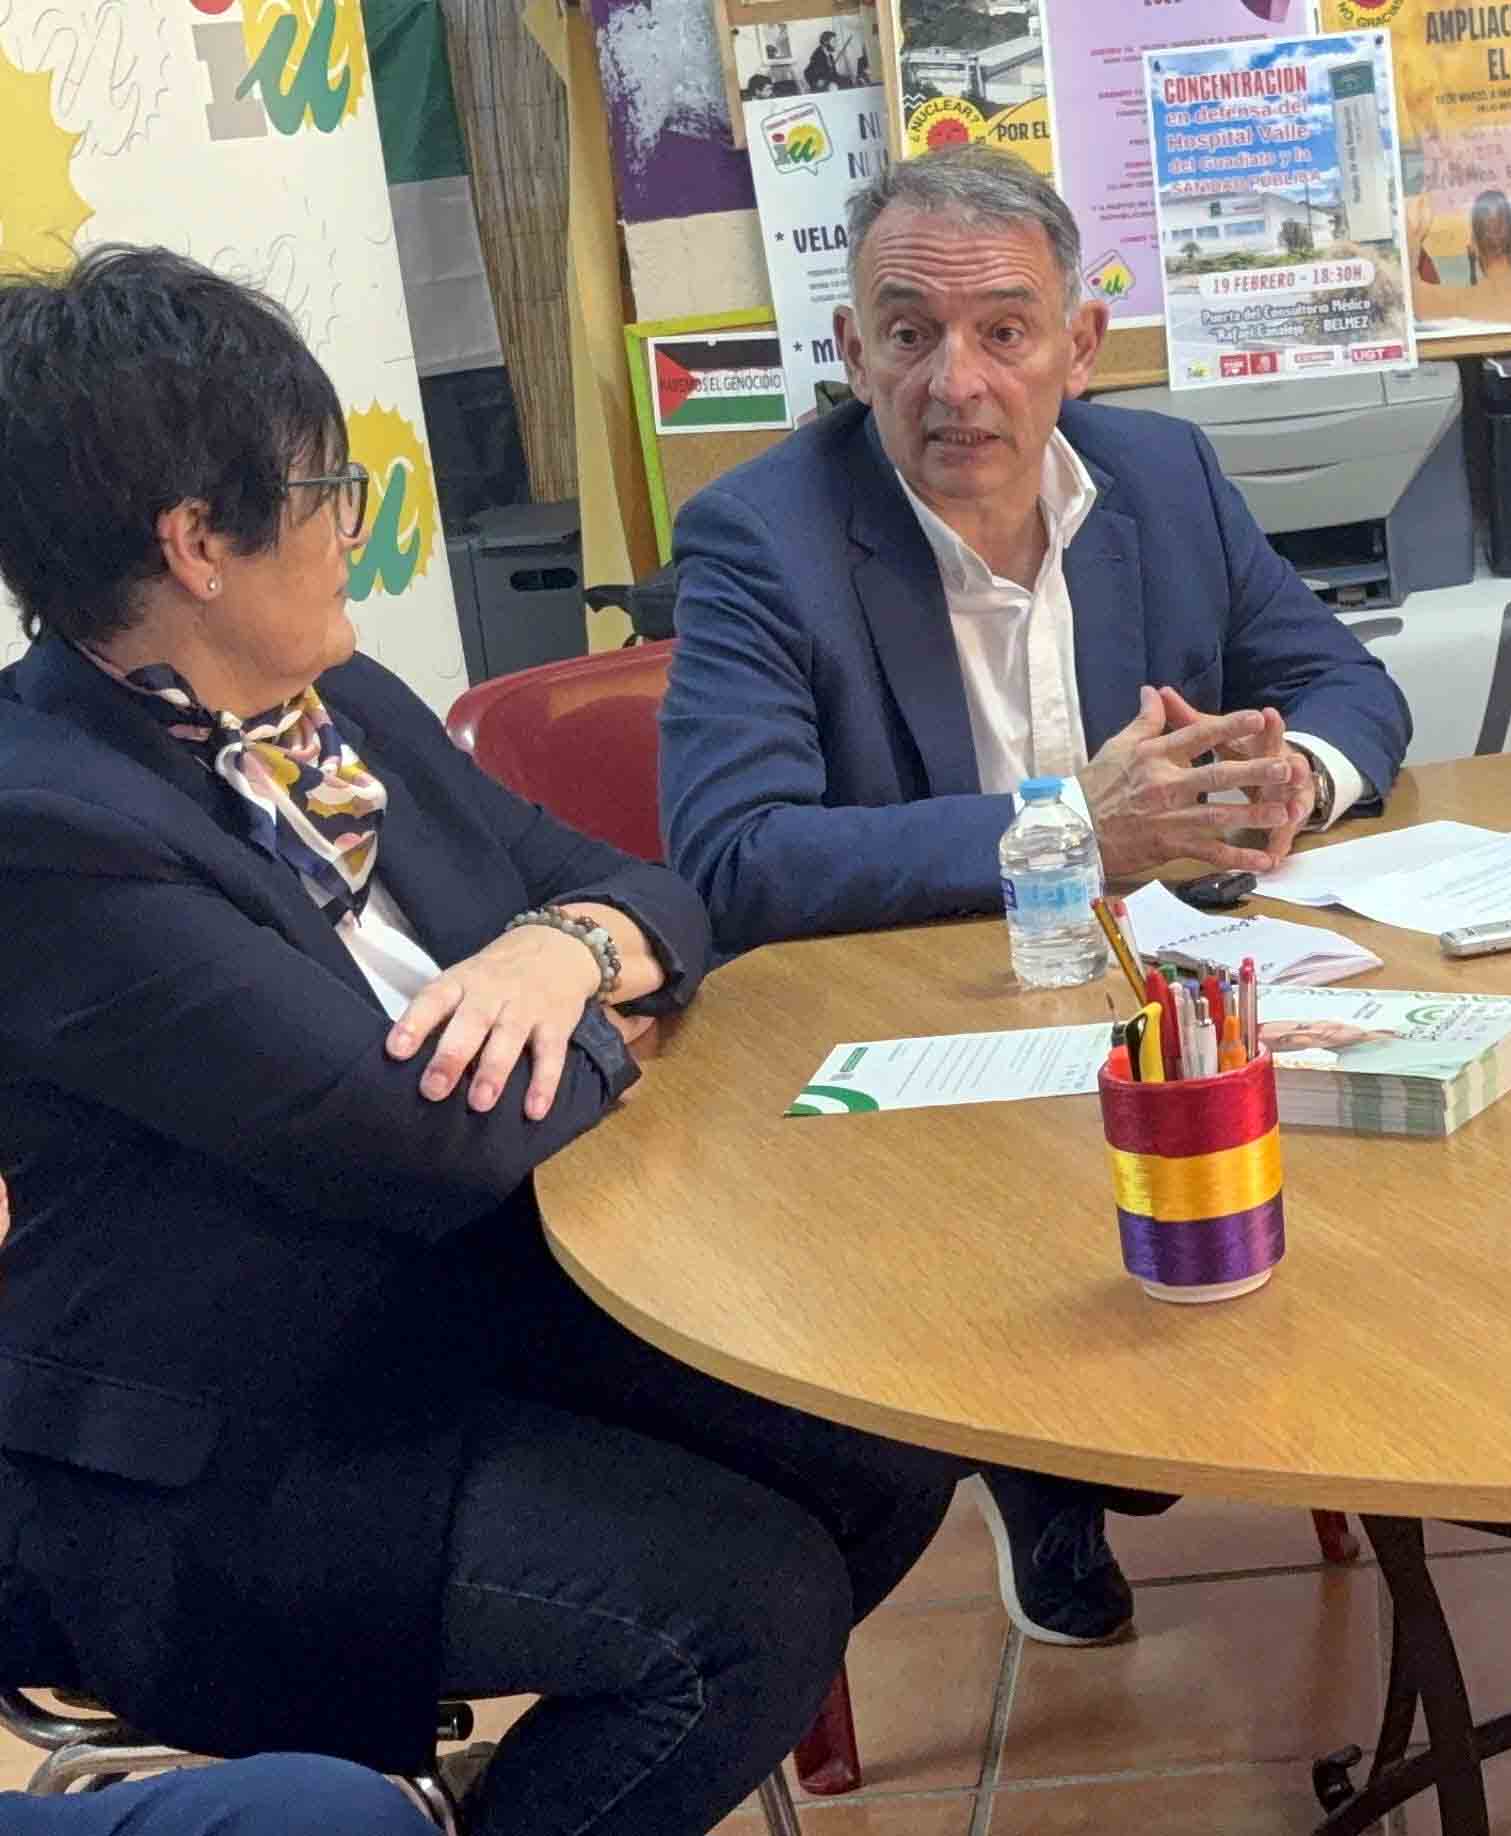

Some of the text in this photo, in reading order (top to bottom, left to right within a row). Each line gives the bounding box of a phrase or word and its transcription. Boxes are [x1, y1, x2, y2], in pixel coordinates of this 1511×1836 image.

[1488, 48, 1510, 81] EL
[1167, 112, 1189, 125] en
[997, 122, 1029, 142] POR
[1032, 121, 1050, 139] EL
[1168, 123, 1311, 153] Hospital Valle
[1213, 278, 1230, 294] 19
[1234, 272, 1295, 292] FEBRERO
[710, 376, 722, 392] EL
[724, 373, 782, 392] GENOCIDIO
